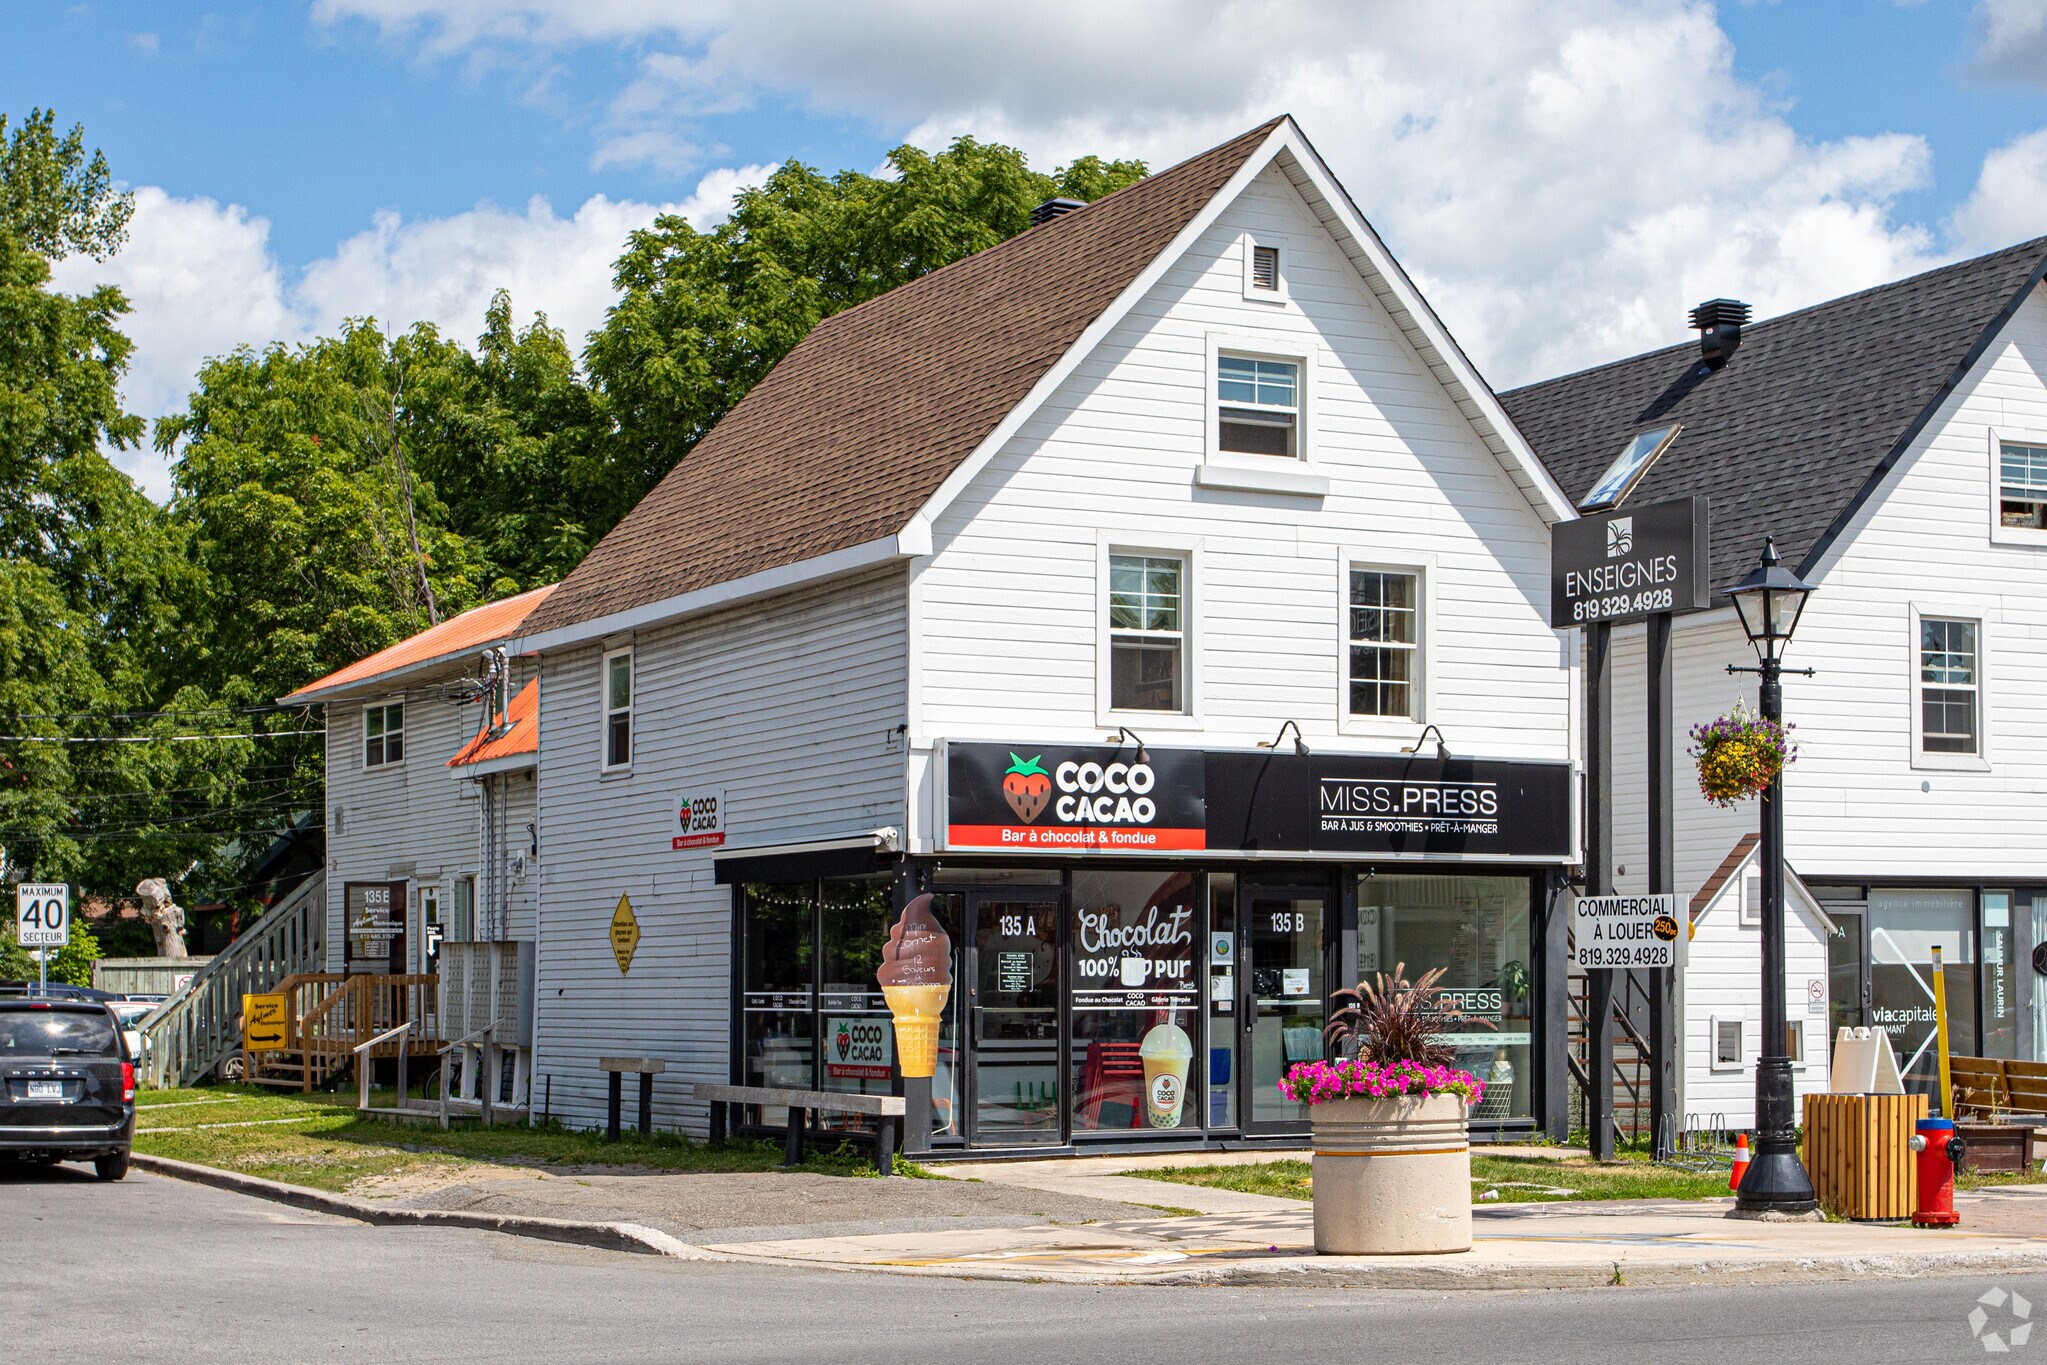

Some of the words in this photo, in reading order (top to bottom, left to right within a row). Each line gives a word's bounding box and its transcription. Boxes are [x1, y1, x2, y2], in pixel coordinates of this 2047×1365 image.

[1566, 555, 1677, 598] ENSEIGNES
[1573, 599, 1599, 621] 819
[1601, 588, 1673, 617] 329.4928
[1055, 761, 1155, 794] COCO
[692, 797, 717, 815] COCO
[1055, 795, 1156, 824] CACAO
[1320, 785, 1498, 815] MISS.PRESS
[692, 815, 717, 831] CACAO
[1321, 821, 1339, 831] BAR
[1340, 818, 1347, 831] À
[1349, 822, 1364, 831] JUS
[1366, 822, 1373, 831] &
[1375, 822, 1423, 833] SMOOTHIES
[1430, 820, 1498, 834] PRÊT-À-MANGER
[687, 836, 703, 846] chocolat
[706, 835, 720, 844] fondue
[1002, 829, 1024, 842] Bar
[1029, 829, 1038, 842] à
[1040, 829, 1095, 844] chocolat
[1098, 831, 1109, 844] &
[1111, 830, 1156, 844] fondue
[22, 887, 64, 896] MAXIMUM
[364, 890, 382, 903] 135
[383, 890, 389, 903] E
[365, 906, 390, 914] Service
[1578, 897, 1669, 917] COMMERCIAL
[1879, 900, 1908, 910] agence
[1912, 898, 1963, 908] immobilière
[22, 899, 64, 930] 40
[353, 914, 379, 928] Aylmer
[1270, 912, 1292, 933] 135
[1295, 913, 1305, 932] B
[999, 915, 1022, 936] 135
[1026, 915, 1036, 936] A
[1078, 904, 1193, 953] Chocolat
[1594, 917, 1603, 940] À
[1608, 922, 1654, 940] LOUER
[23, 932, 62, 942] SECTEUR
[913, 954, 923, 965] 12
[1579, 947, 1668, 965] 819.329.4928
[1996, 933, 2004, 977] SAUMUR
[1078, 955, 1120, 977] 100%
[1997, 979, 2005, 1018] LAURIN
[1872, 1006, 1938, 1025] viacapitale
[851, 1025, 882, 1044] COCO
[851, 1045, 882, 1062] CACAO
[833, 1067, 841, 1075] Bar
[845, 1067, 864, 1076] chocolat
[869, 1068, 886, 1077] fondue
